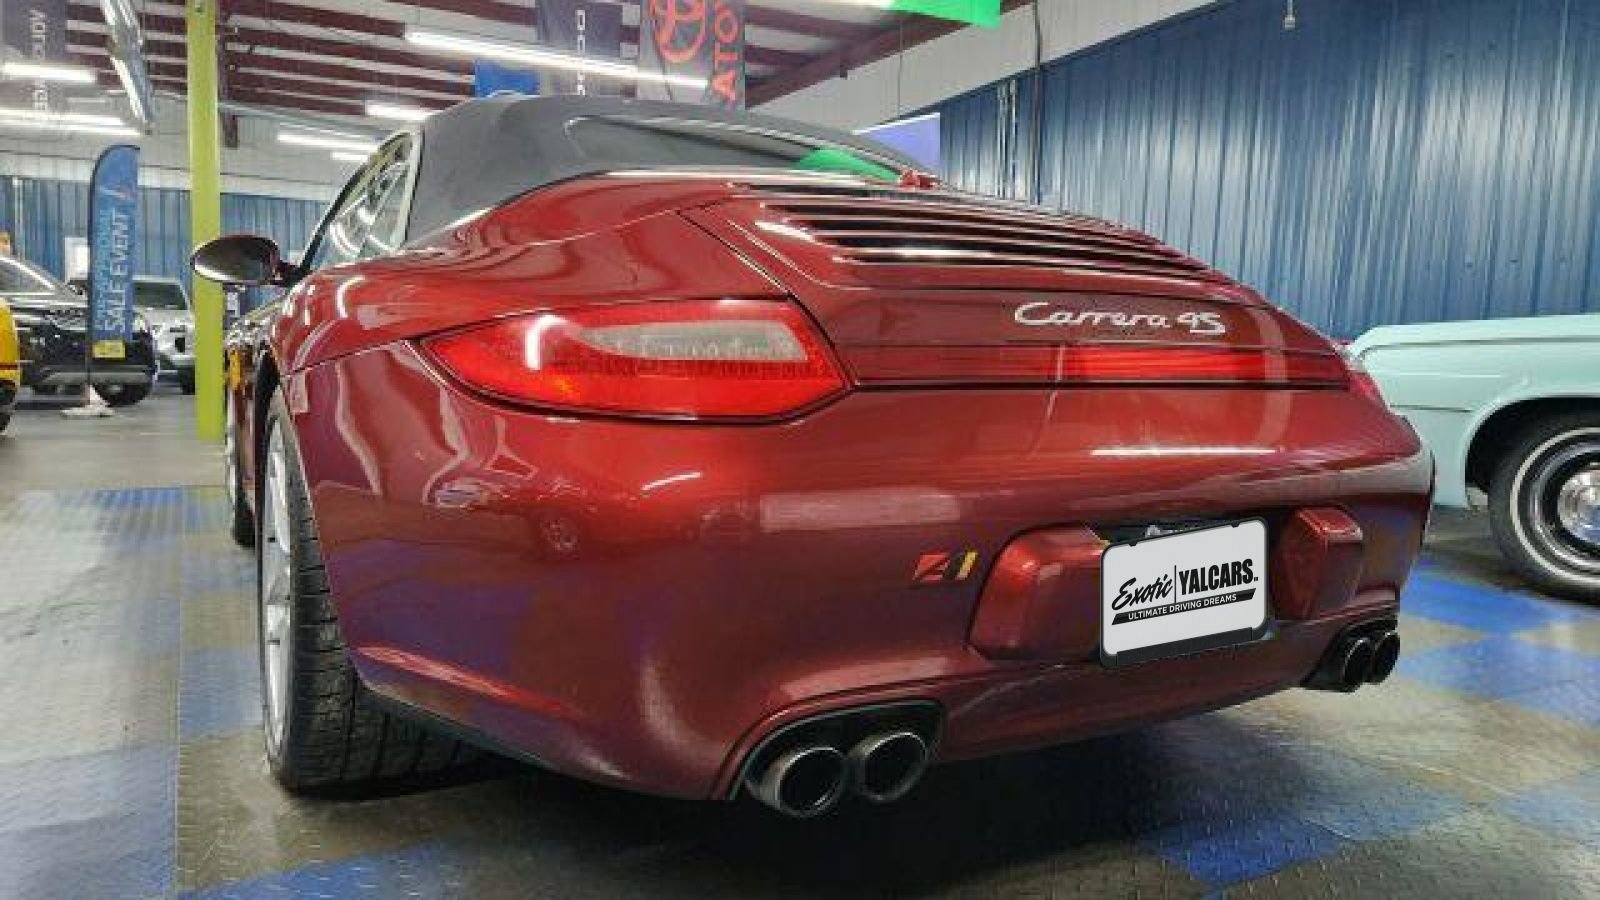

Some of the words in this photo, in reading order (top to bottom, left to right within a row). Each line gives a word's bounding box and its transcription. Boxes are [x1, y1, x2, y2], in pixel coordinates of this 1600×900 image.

[109, 208, 129, 276] EVENT
[105, 279, 126, 333] SALE
[1014, 301, 1172, 329] Carrera
[1177, 311, 1226, 334] 4S
